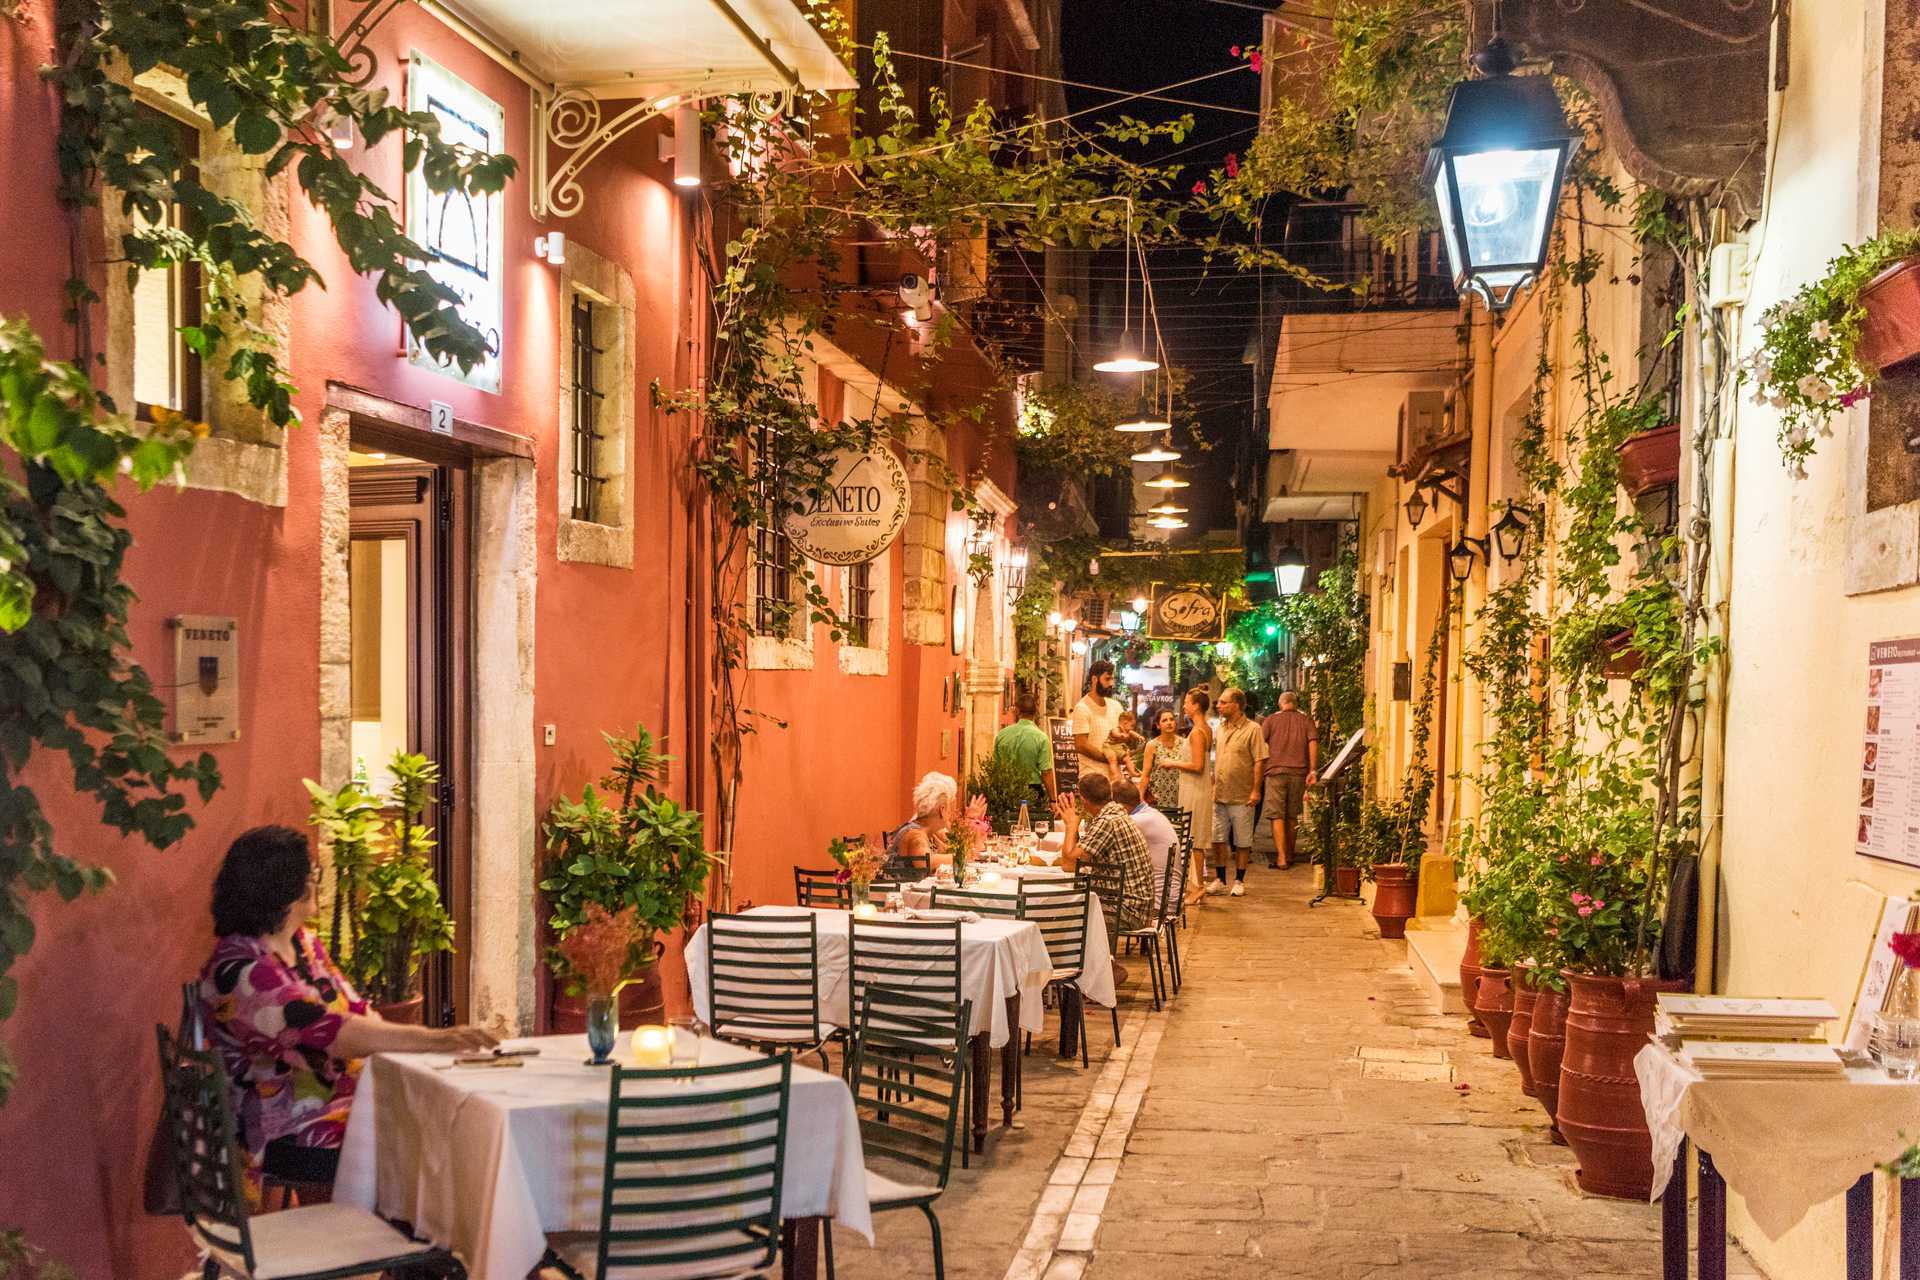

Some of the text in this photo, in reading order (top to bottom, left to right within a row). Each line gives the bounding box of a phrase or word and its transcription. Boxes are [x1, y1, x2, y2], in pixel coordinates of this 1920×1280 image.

[439, 409, 446, 428] 2
[810, 516, 881, 528] Exclusive Suites
[1163, 598, 1210, 620] Sofra
[185, 629, 230, 641] VENETO
